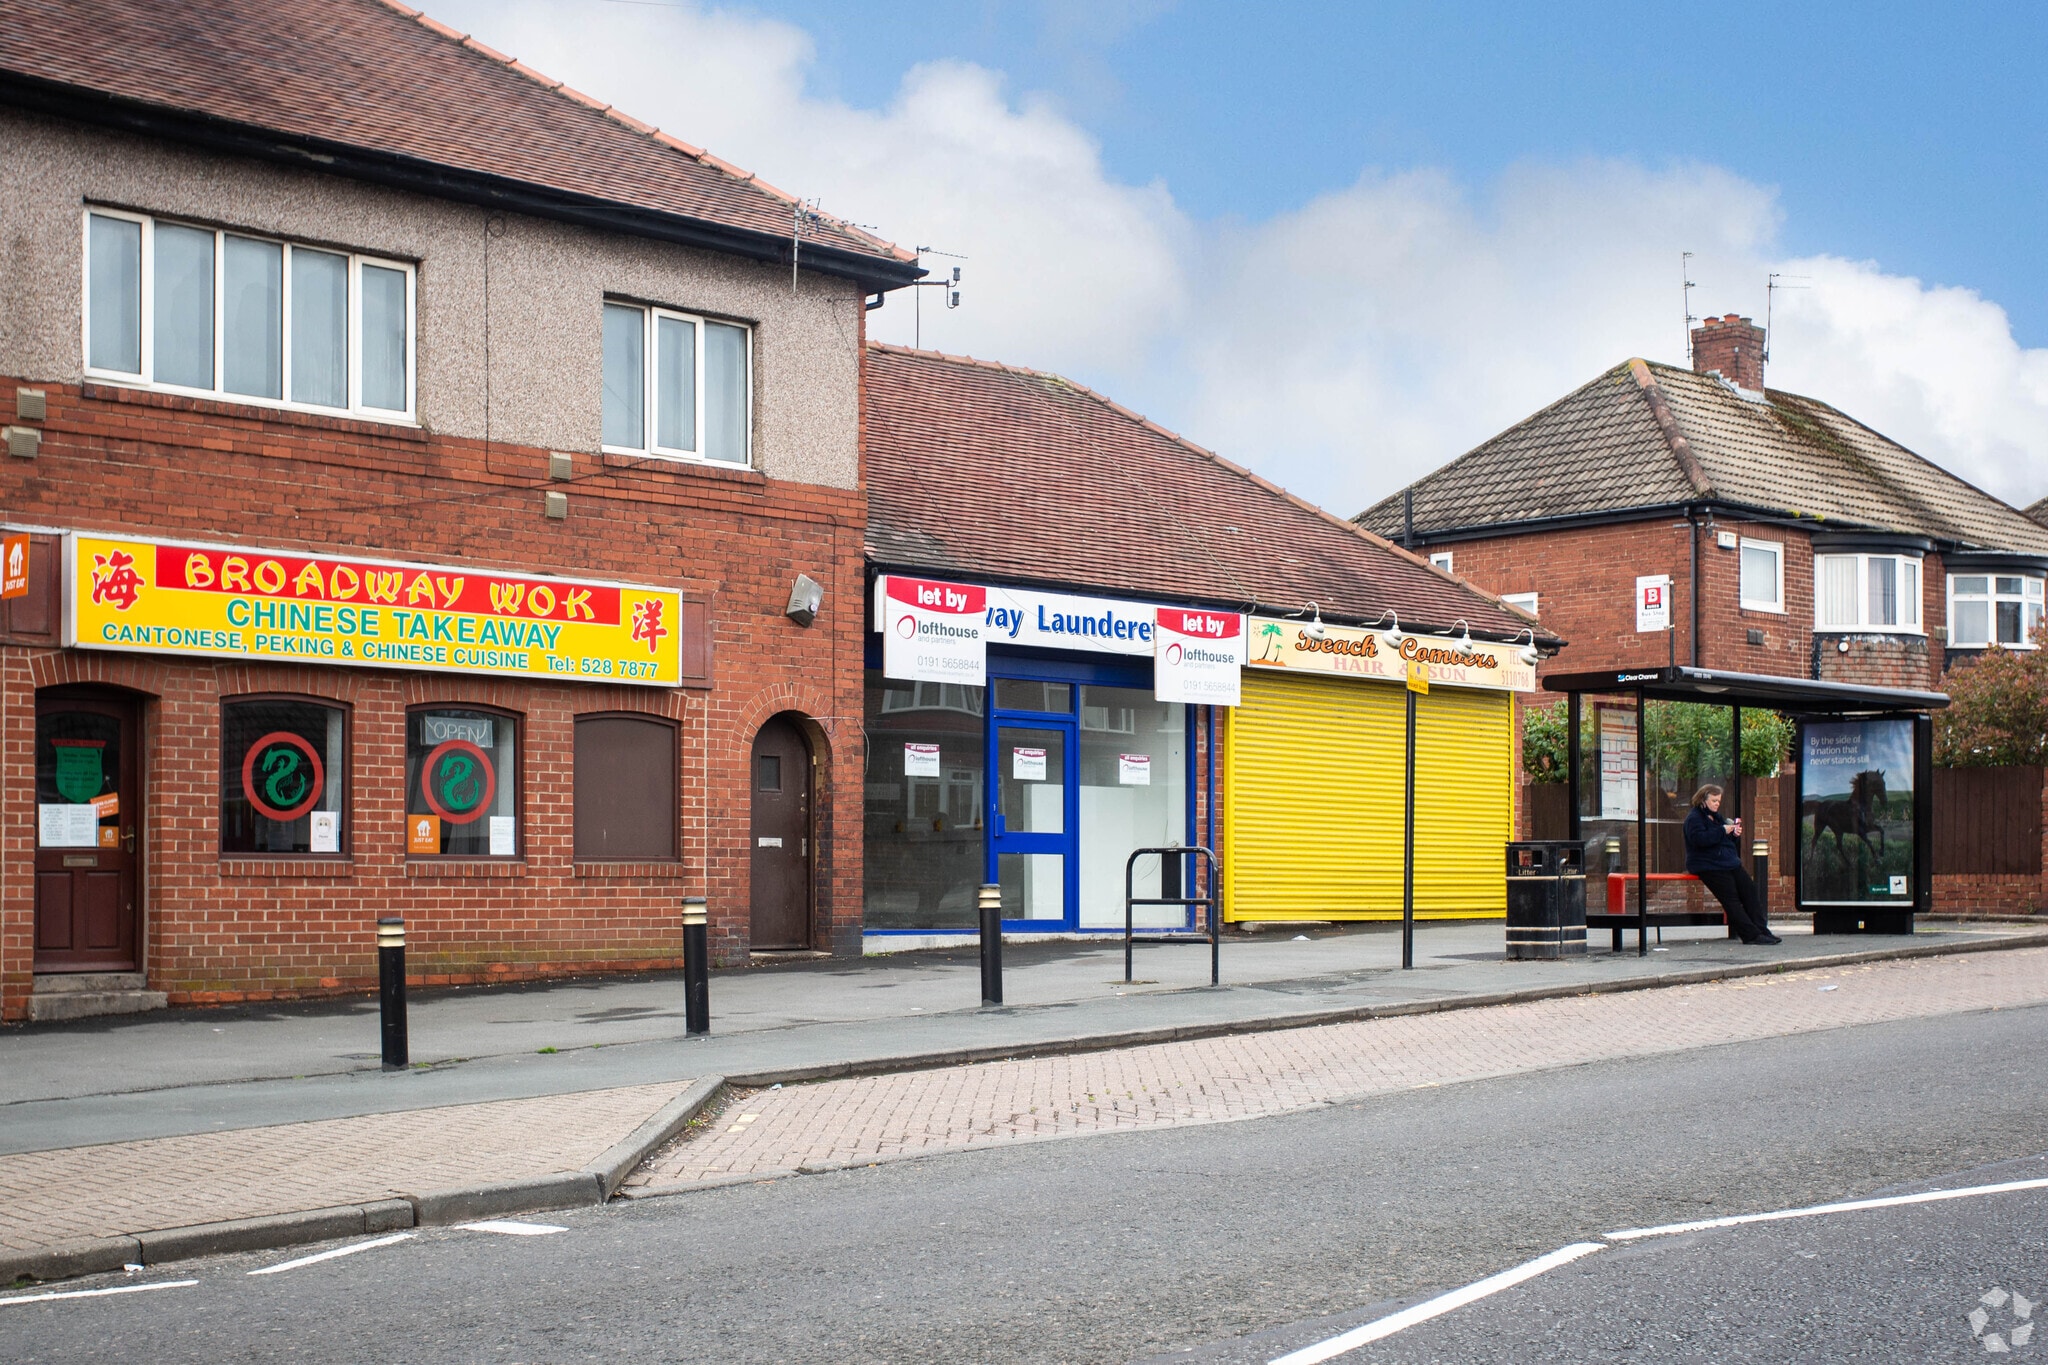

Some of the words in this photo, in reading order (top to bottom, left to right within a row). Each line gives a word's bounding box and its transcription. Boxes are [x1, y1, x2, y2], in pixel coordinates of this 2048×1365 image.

[92, 549, 145, 611] 海
[185, 552, 465, 609] BROADWAY
[489, 582, 596, 621] WOK
[918, 585, 941, 606] let
[946, 588, 968, 612] by
[1648, 589, 1658, 602] B
[226, 599, 380, 636] CHINESE
[393, 612, 562, 650] TAKEAWAY
[631, 598, 668, 654] 洋
[918, 620, 979, 639] lofthouse
[1183, 614, 1203, 632] let
[1206, 615, 1225, 637] by
[918, 635, 930, 643] and
[931, 637, 956, 645] partners
[102, 623, 248, 653] CANTONESE,
[256, 635, 334, 656] PEKING
[341, 641, 354, 656] &
[362, 642, 447, 664] CHINESE
[453, 648, 529, 669] CUISINE
[546, 655, 575, 672] Tel:
[581, 658, 613, 674] 528
[619, 661, 658, 678] 7877
[1183, 648, 1235, 664] lofthouse
[917, 656, 939, 667] 0191
[942, 657, 980, 670] 5658844
[1334, 657, 1385, 674] HAIR
[1428, 665, 1467, 682] SUN
[1638, 672, 1659, 680] Channel
[433, 721, 480, 743] OPEN
[1811, 736, 1820, 747] By
[1821, 735, 1835, 745] the
[1836, 735, 1852, 744] side
[1852, 734, 1861, 743] of
[1811, 757, 1830, 765] never
[1831, 756, 1856, 764] stands
[1857, 754, 1870, 763] still
[1816, 746, 1841, 755] nation
[1842, 745, 1858, 754] that
